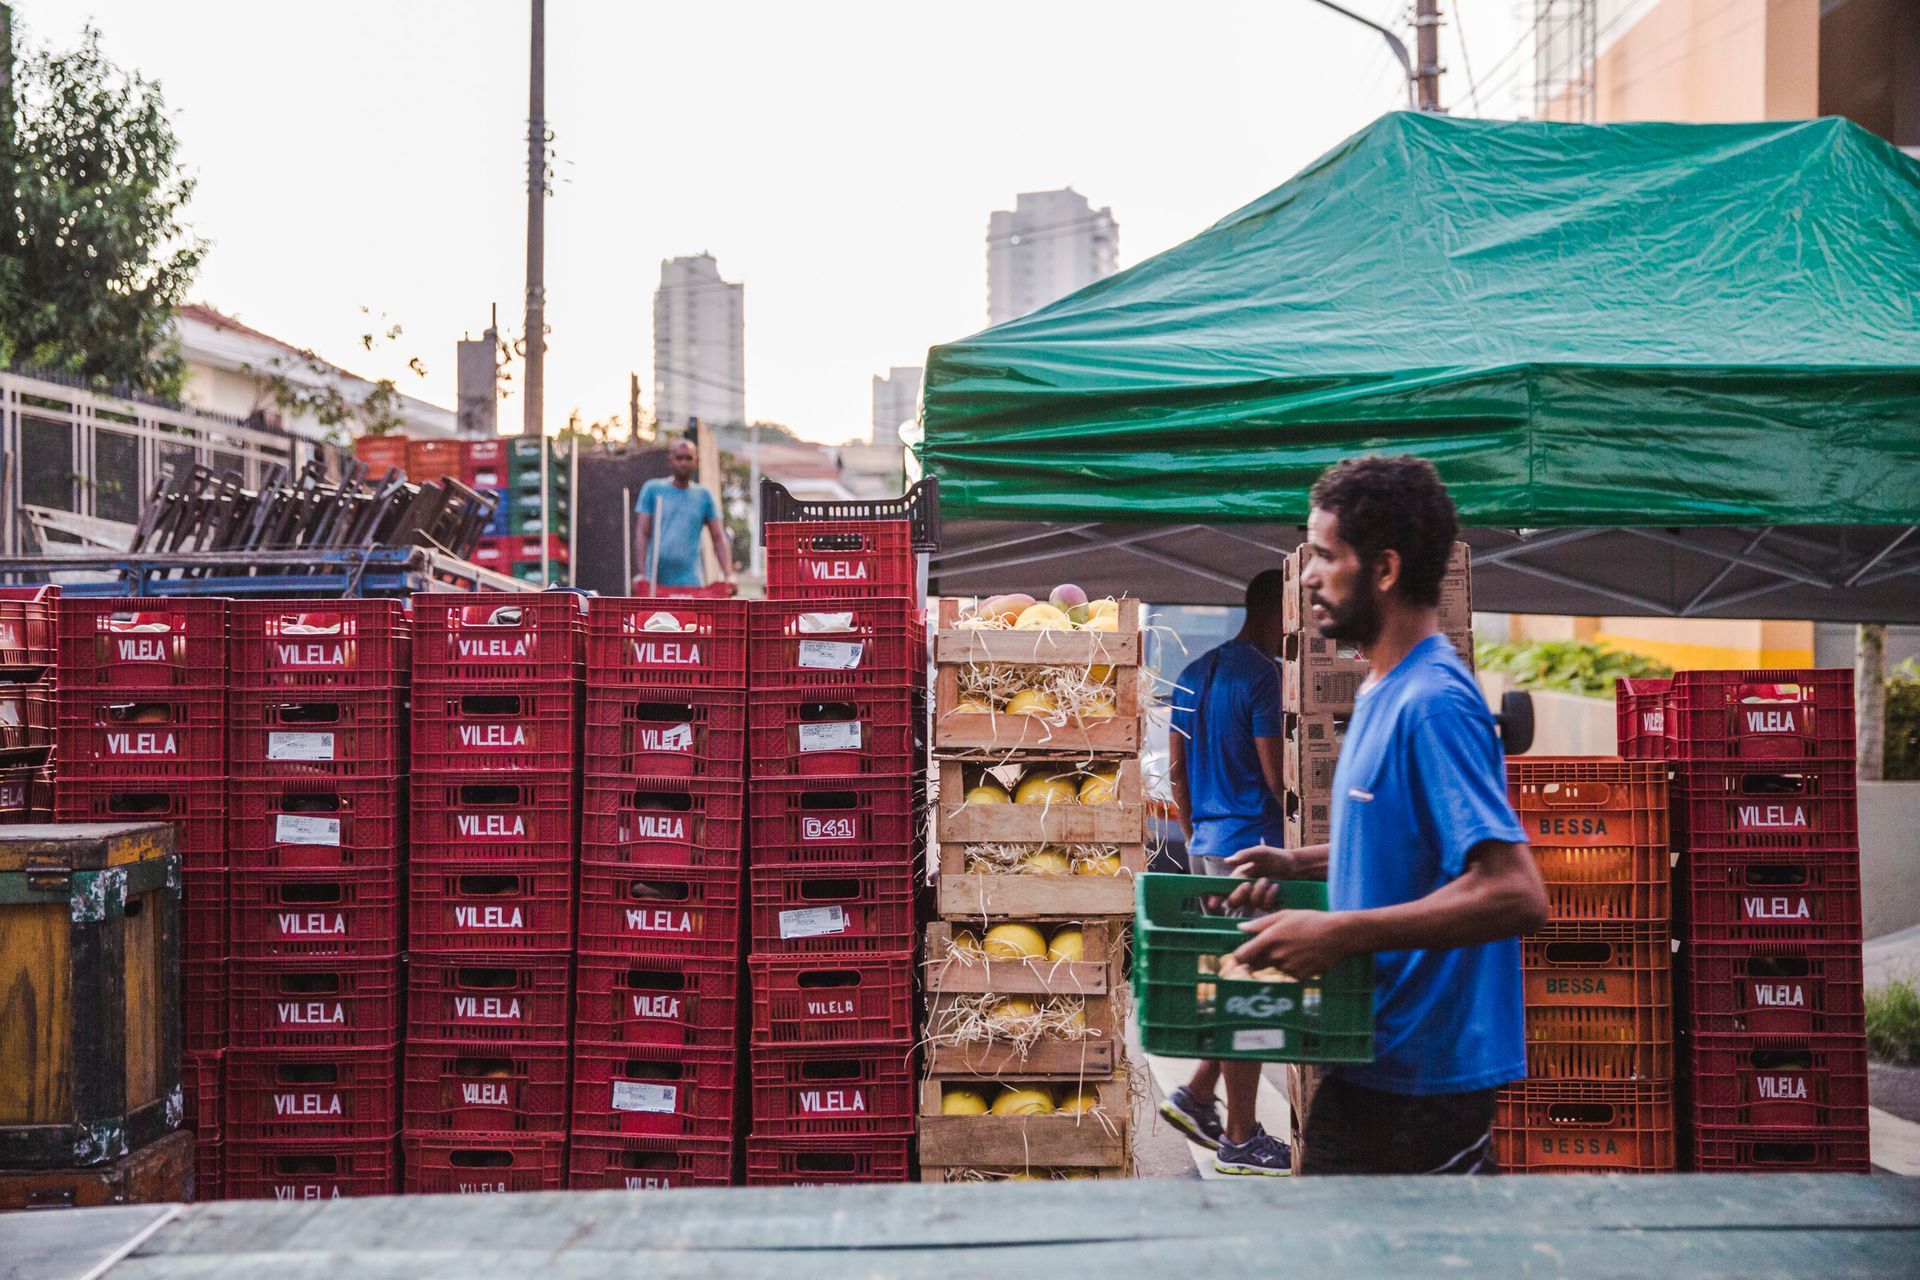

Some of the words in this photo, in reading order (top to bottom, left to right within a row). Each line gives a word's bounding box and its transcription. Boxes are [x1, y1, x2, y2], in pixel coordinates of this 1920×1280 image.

[813, 562, 866, 579] VILELA
[118, 640, 165, 660] VILELA
[279, 642, 346, 664] VILELA
[459, 638, 527, 655] VILELA
[633, 642, 700, 663] VILELA
[1747, 711, 1795, 732] VILELA
[107, 734, 176, 753] VILELA
[460, 726, 525, 745] VILELA
[458, 816, 524, 835] VILELA
[1539, 817, 1607, 834] BESSA
[1739, 806, 1806, 826] VILELA
[639, 816, 683, 838] VILELA
[456, 907, 522, 927] VILELA
[1744, 898, 1809, 918] VILELA
[279, 914, 345, 933] VILELA
[626, 910, 691, 932] VILELA
[1546, 977, 1606, 993] BESSA
[1756, 985, 1803, 1005] VILELA
[279, 1003, 344, 1023] VILELA
[455, 998, 520, 1018] VILELA
[634, 996, 680, 1018] VILELA
[808, 1001, 853, 1014] VILELA
[463, 1084, 508, 1104] VILELA
[1757, 1077, 1807, 1098] VILELA
[274, 1094, 341, 1114] VILELA
[800, 1091, 864, 1111] VILELA
[1540, 1137, 1619, 1154] BESSA
